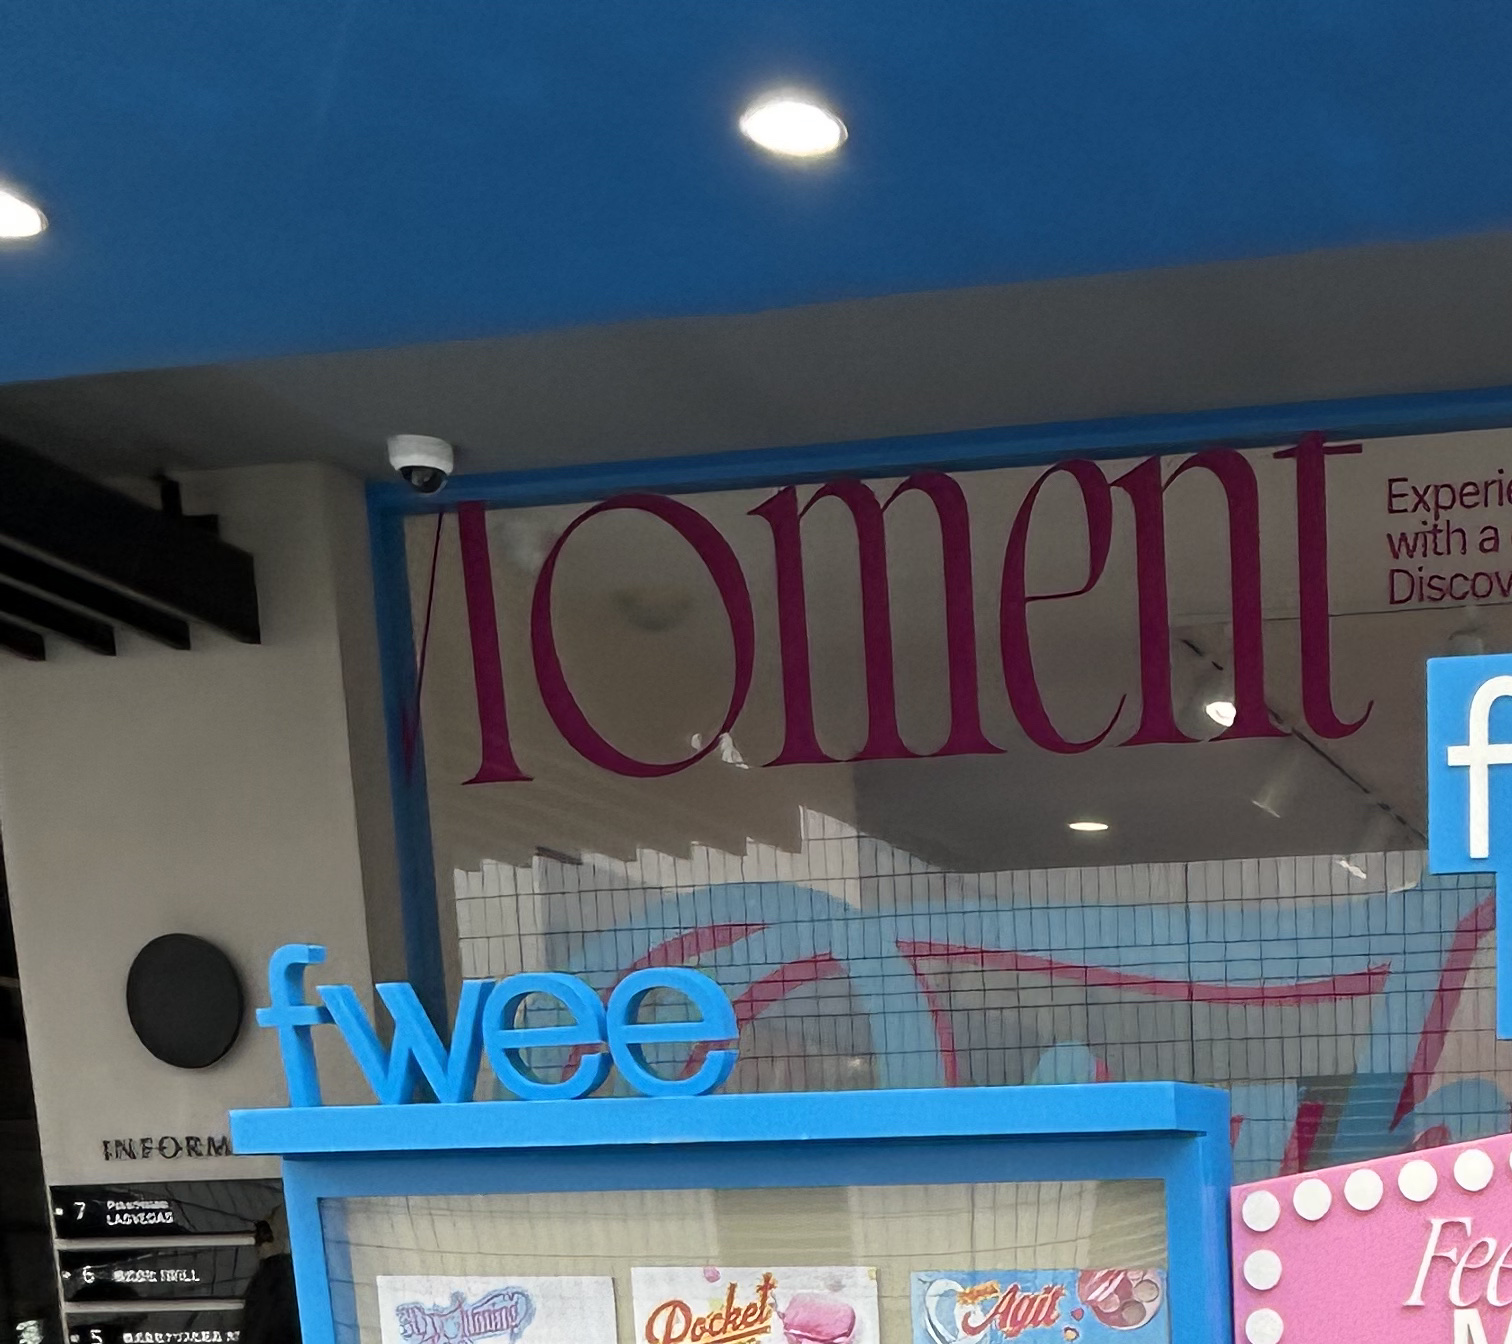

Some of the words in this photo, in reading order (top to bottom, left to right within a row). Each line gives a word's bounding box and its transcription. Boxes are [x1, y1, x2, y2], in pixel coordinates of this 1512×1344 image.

[1387, 520, 1467, 559] with
[1478, 525, 1499, 553] a
[257, 944, 740, 1106] fwee
[73, 1201, 87, 1221] 7
[82, 1265, 95, 1284] 6
